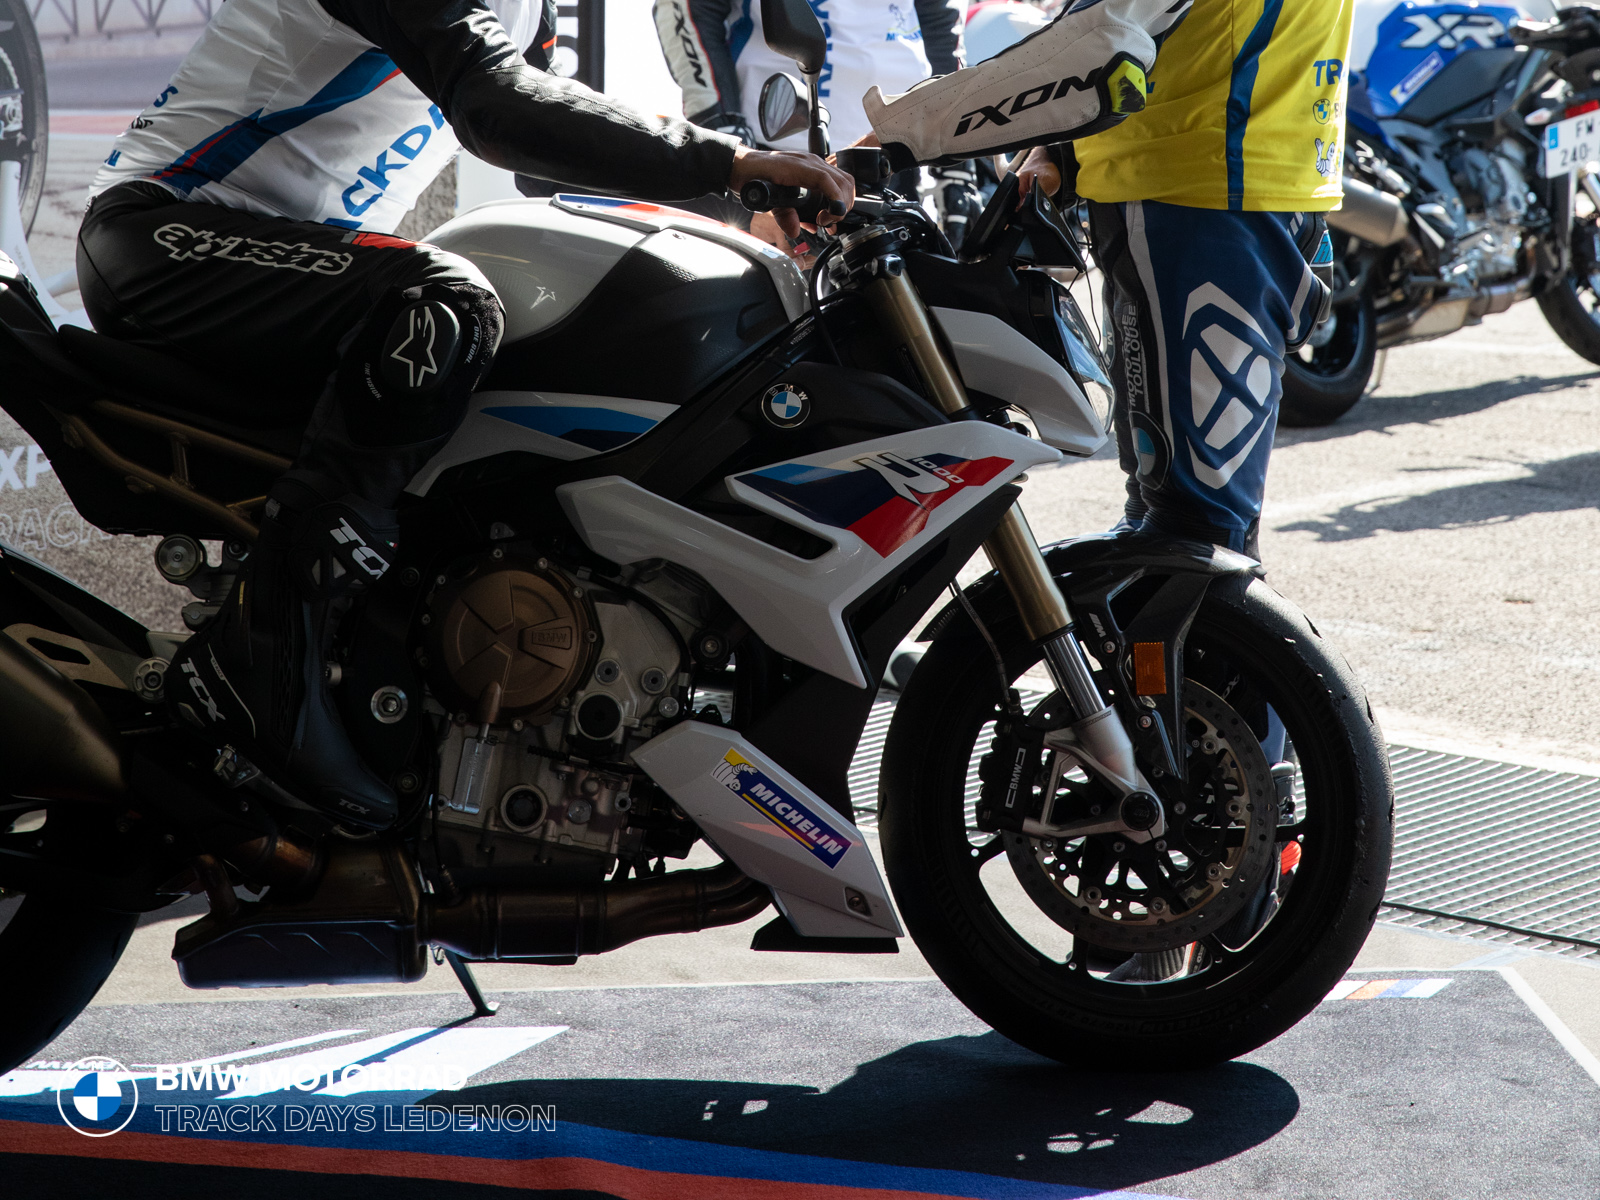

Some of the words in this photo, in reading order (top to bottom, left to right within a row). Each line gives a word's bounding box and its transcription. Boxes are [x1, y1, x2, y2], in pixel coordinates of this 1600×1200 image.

[1400, 13, 1505, 50] XR
[1313, 58, 1345, 87] TR
[1128, 304, 1144, 395] TOULOUSE
[768, 383, 809, 401] BMW
[1125, 357, 1137, 407] MOTO
[0, 443, 52, 492] XP
[537, 631, 568, 643] BMW
[180, 656, 226, 722] TCX
[1009, 763, 1023, 790] BMW
[338, 798, 371, 815] TCX
[750, 782, 843, 856] MICHELIN
